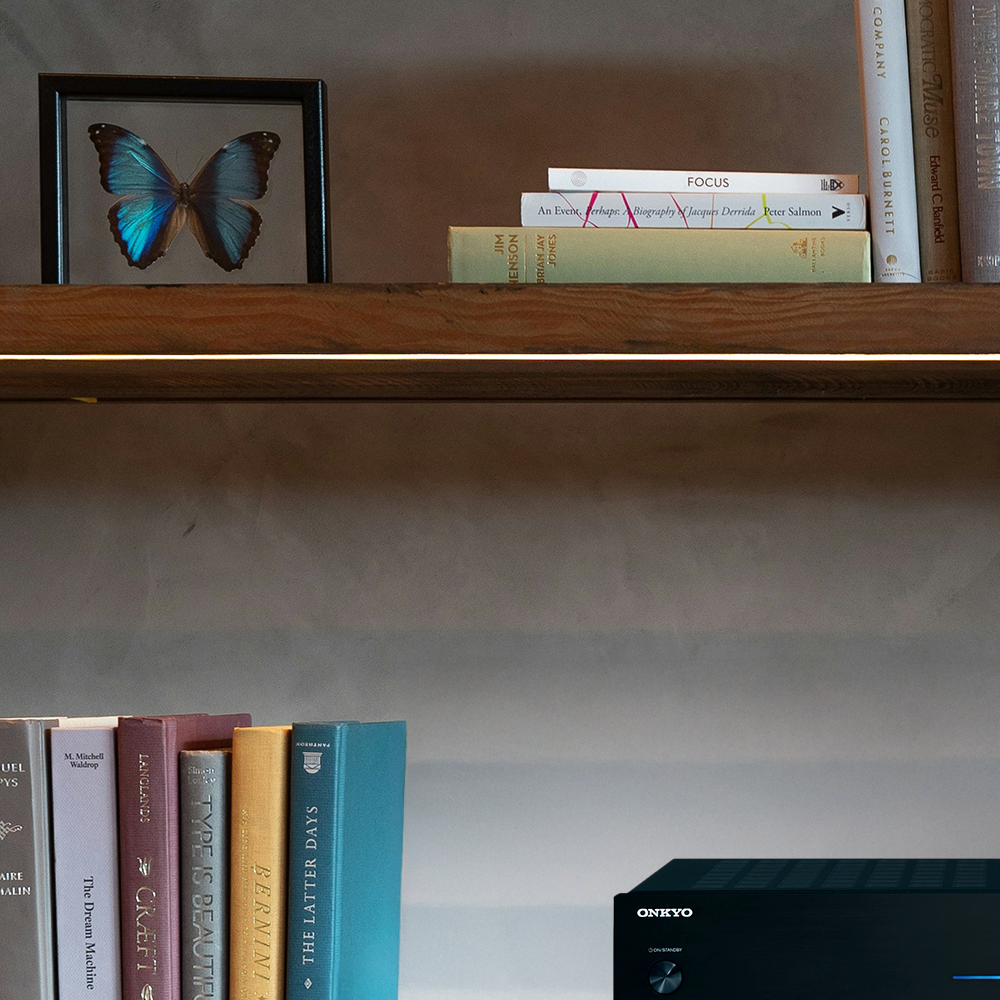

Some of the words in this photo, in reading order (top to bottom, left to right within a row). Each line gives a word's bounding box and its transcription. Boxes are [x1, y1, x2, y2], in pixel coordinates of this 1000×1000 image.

[872, 6, 887, 79] COMPANY
[878, 116, 891, 165] CAROL
[687, 176, 730, 189] FOCUS
[538, 206, 552, 216] An
[554, 206, 582, 217] Event,
[633, 206, 675, 219] Biography
[687, 206, 719, 219] Jacques
[721, 206, 756, 217] Derrida
[763, 206, 787, 217] Peter
[788, 207, 822, 217] Salmon
[882, 171, 895, 235] BURNETT
[494, 234, 505, 256] JIM
[536, 234, 546, 253] JAY
[547, 234, 558, 268] JONES
[69, 760, 99, 770] Waldrop
[75, 752, 105, 761] Mitchell
[190, 794, 213, 859] TYPE
[305, 805, 319, 851] DAYS
[83, 875, 94, 899] The
[191, 866, 214, 885] IS
[303, 857, 317, 925] LATTER
[84, 902, 95, 939] Dream
[251, 862, 272, 981] BERNINI
[637, 907, 694, 918] ONKYO
[302, 930, 315, 965] THE
[85, 942, 97, 991] Machine
